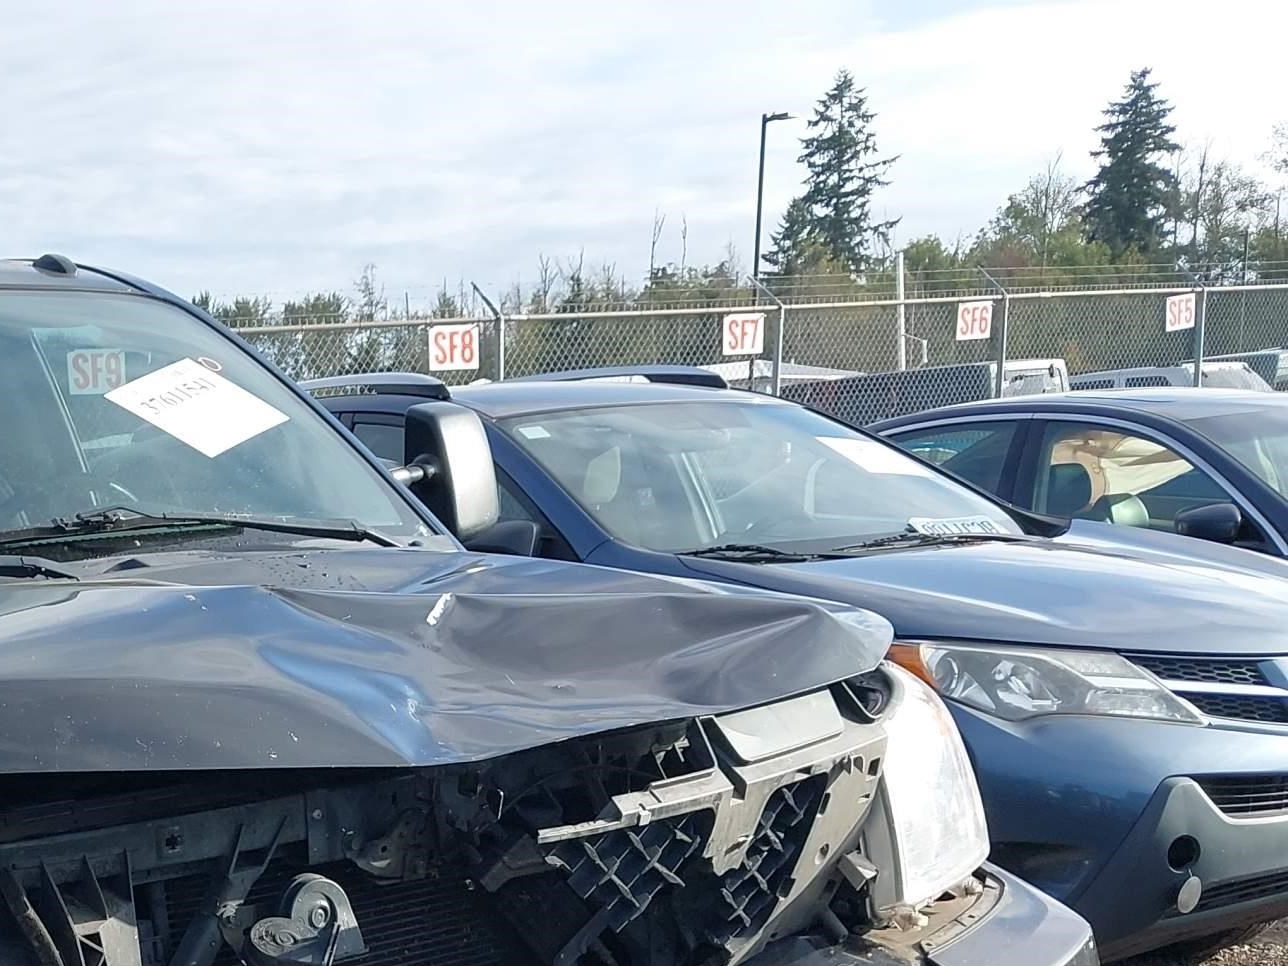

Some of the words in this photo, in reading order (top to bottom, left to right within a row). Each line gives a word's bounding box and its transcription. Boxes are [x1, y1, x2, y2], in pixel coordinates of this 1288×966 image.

[960, 305, 989, 336] SF6
[1169, 298, 1193, 327] SF5
[434, 329, 474, 364] SF8
[728, 319, 759, 350] SF7
[72, 353, 121, 390] SF9
